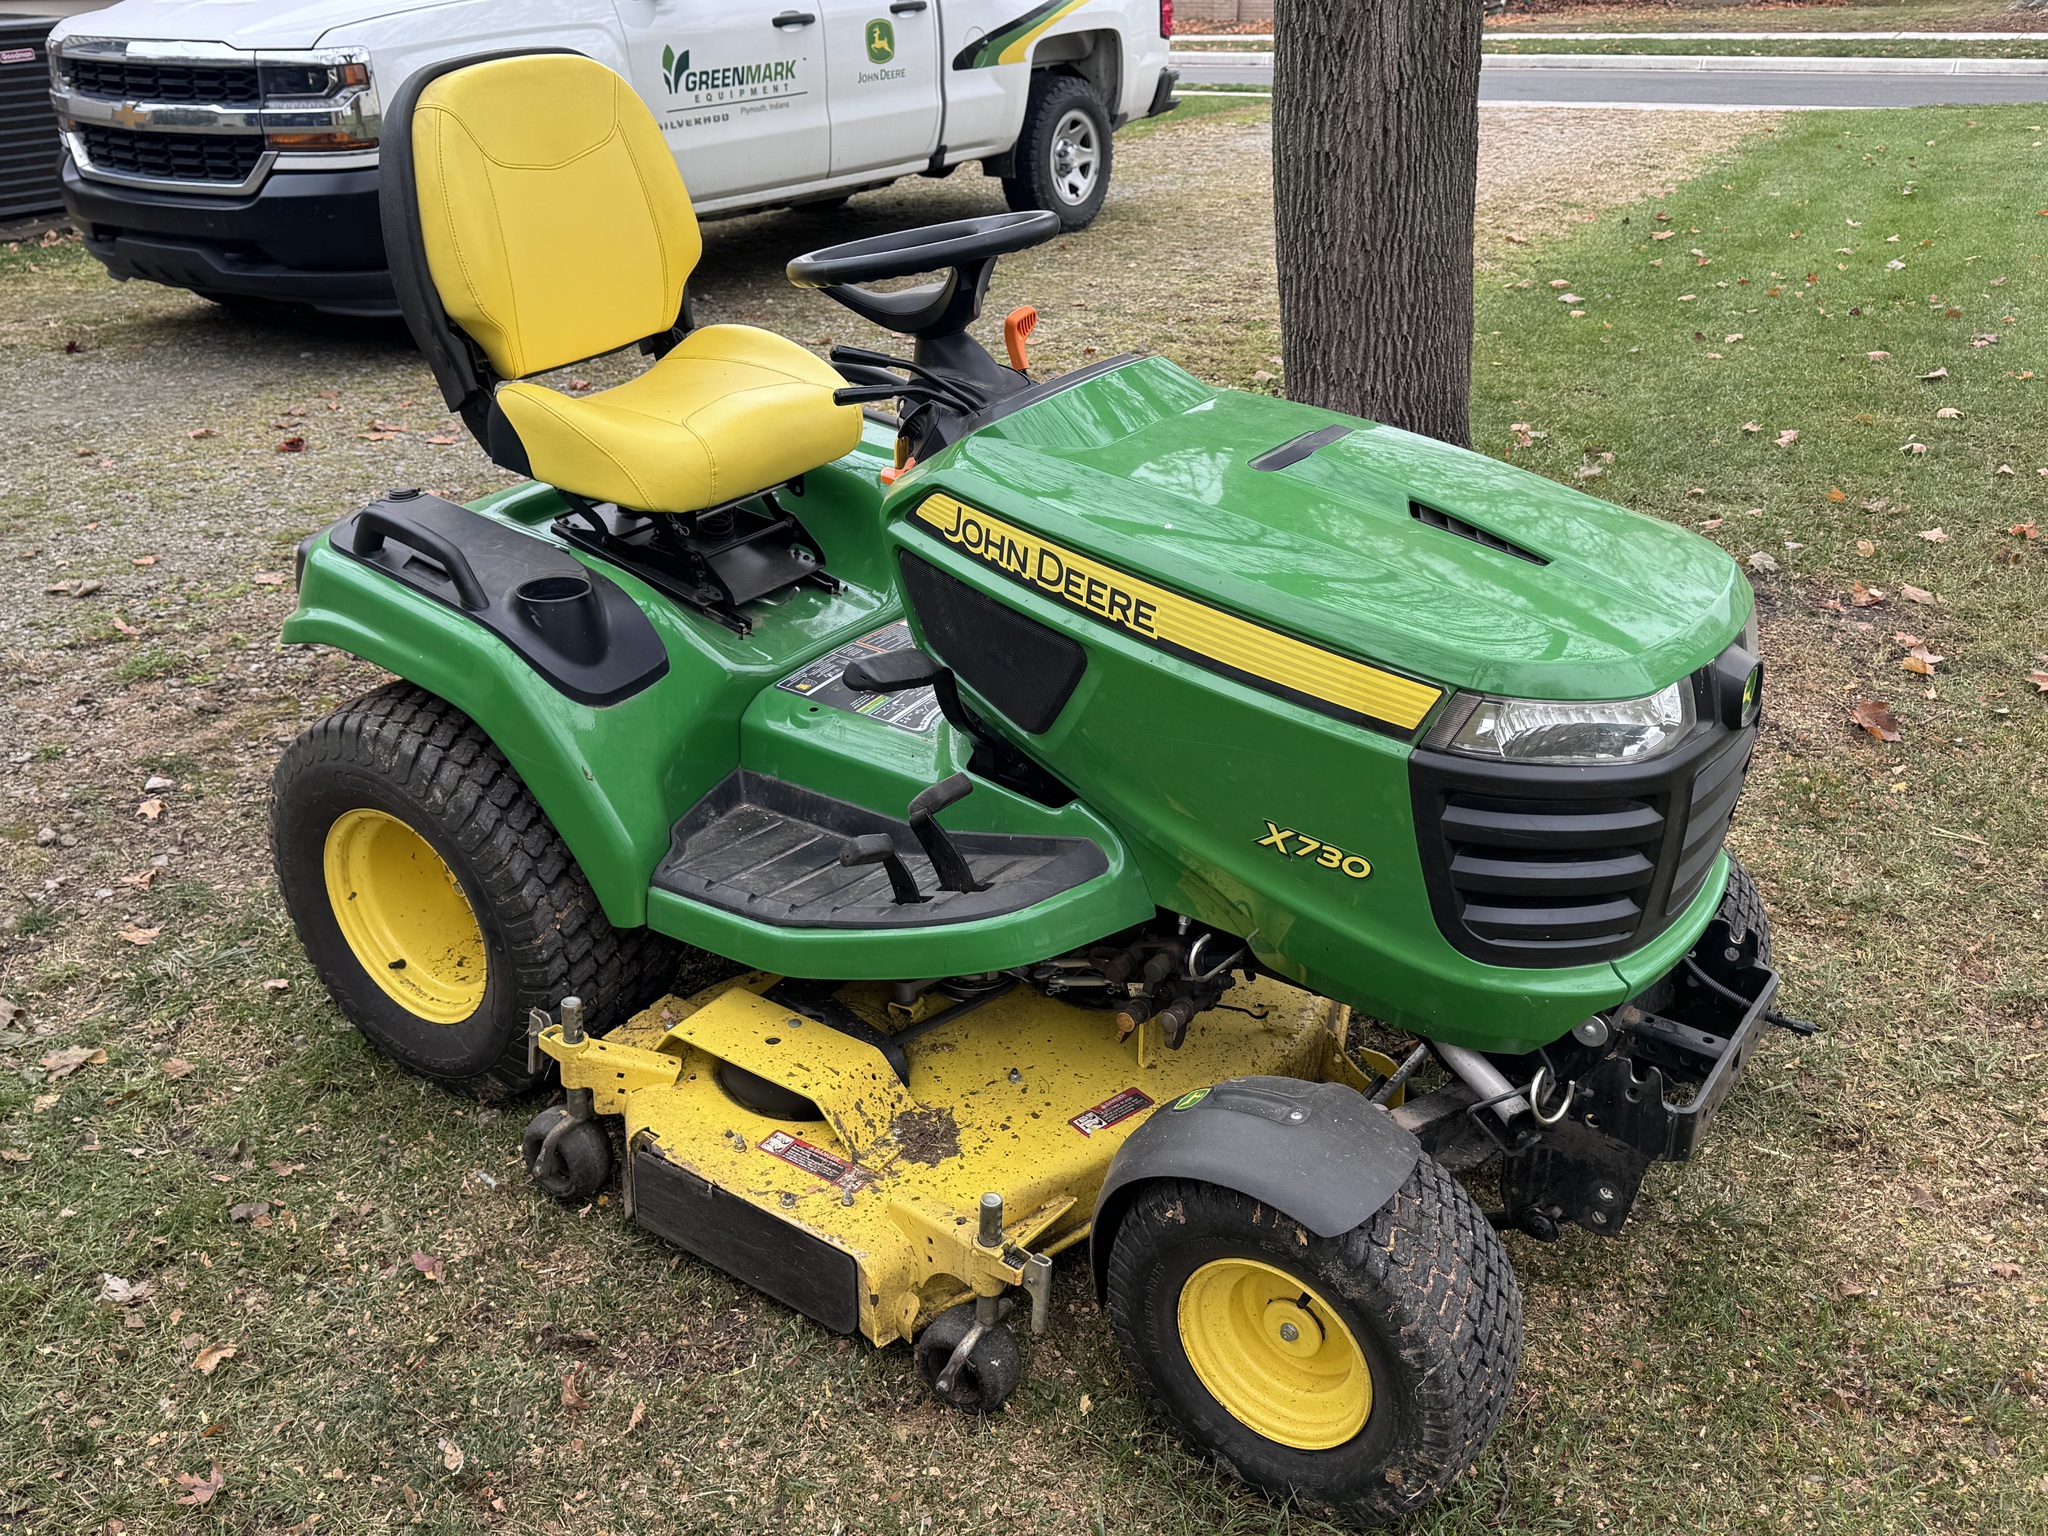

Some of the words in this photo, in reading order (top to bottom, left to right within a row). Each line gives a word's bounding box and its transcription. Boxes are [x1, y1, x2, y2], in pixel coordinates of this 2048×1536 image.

[685, 59, 797, 92] GREENMARK
[857, 71, 880, 84] JOHN
[880, 68, 906, 81] DEERE
[694, 83, 789, 104] EQUIPMENT
[769, 101, 790, 111] Indiana
[943, 505, 1030, 578] JOHN
[1036, 546, 1159, 636] DEERE
[1256, 820, 1372, 880] X730
[814, 1147, 841, 1163] DANGER
